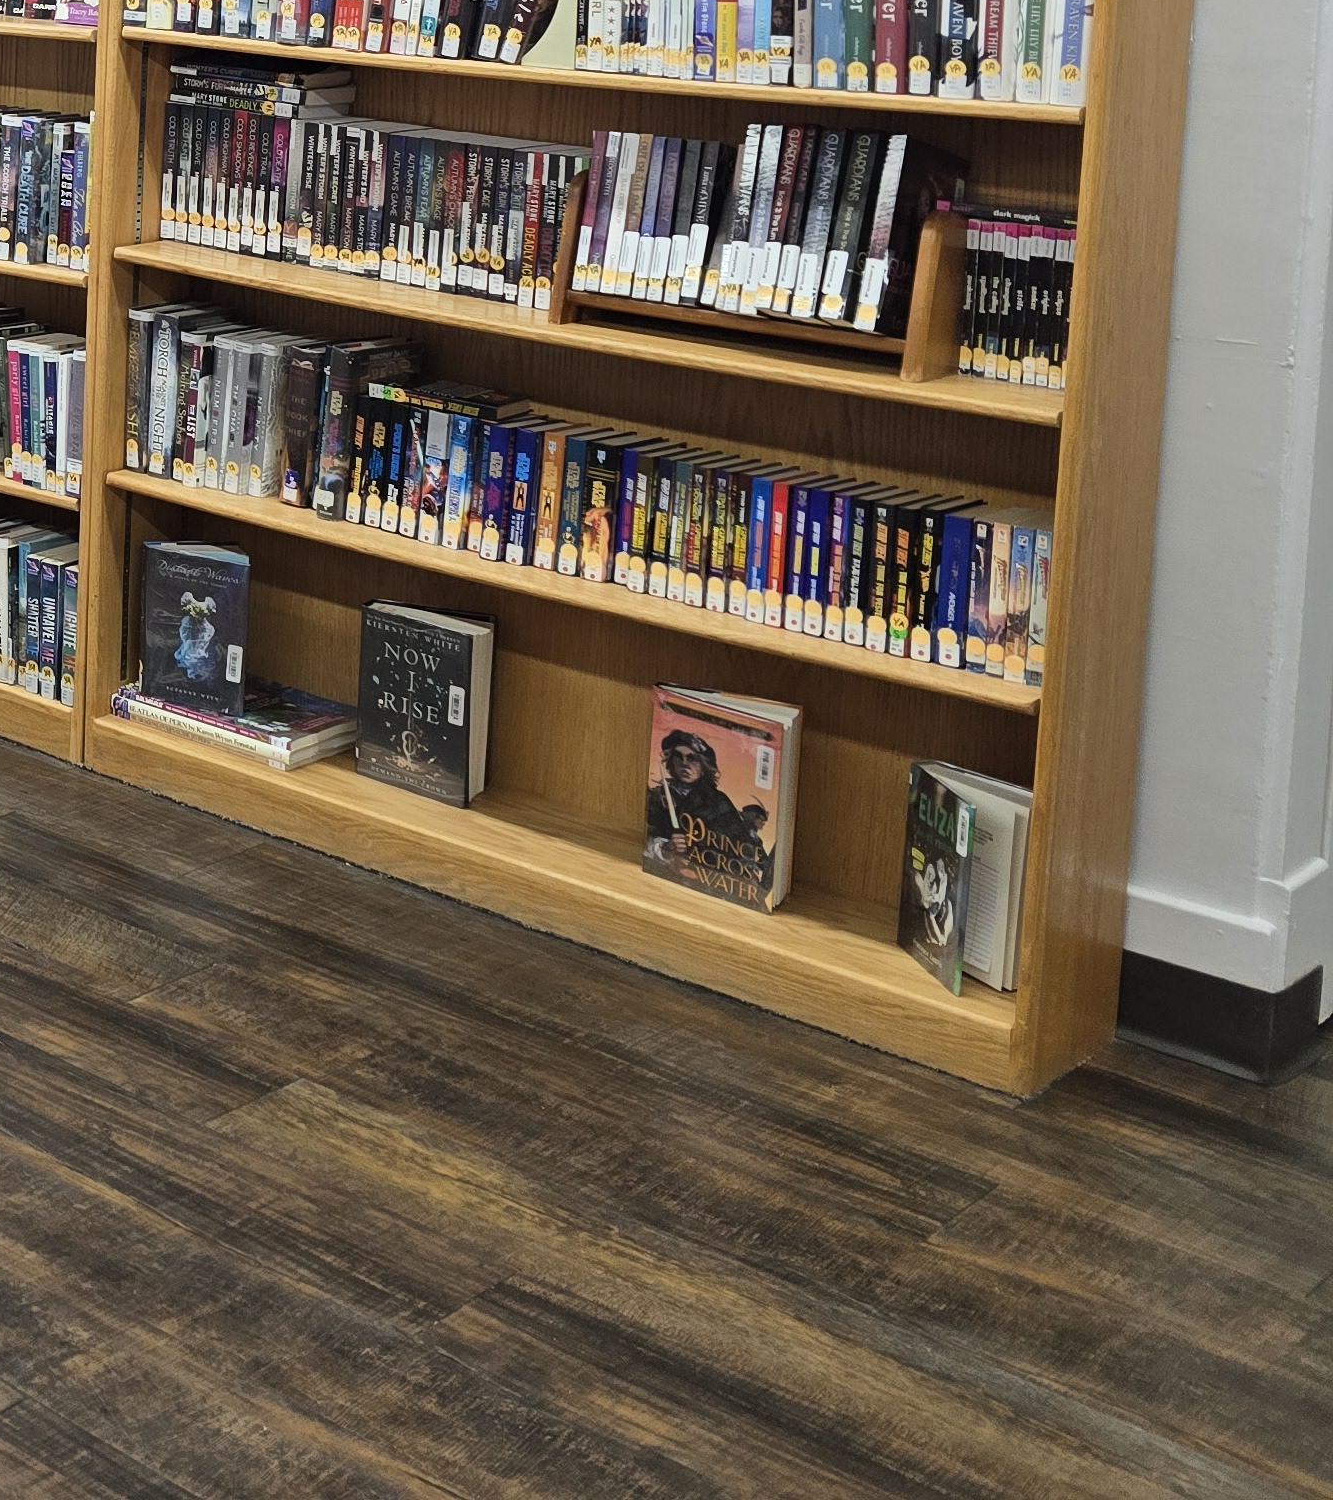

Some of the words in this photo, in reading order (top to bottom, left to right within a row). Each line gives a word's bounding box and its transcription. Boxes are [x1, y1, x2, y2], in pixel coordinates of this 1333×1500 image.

[229, 97, 258, 112] DEADLY
[20, 162, 33, 201] DEATH
[17, 203, 29, 235] CURE
[157, 328, 171, 376] TORCH
[287, 411, 309, 424] BOOK
[156, 559, 204, 580] Distant
[207, 569, 244, 586] Waves
[27, 597, 39, 638] SHATTER
[42, 597, 56, 645] UNRAVEL
[63, 610, 77, 651] IGNITE
[366, 618, 419, 641] KIERSTEN
[424, 636, 461, 653] WHITE
[41, 646, 55, 665] ME
[383, 642, 441, 672] NOW
[408, 671, 416, 693] I
[382, 691, 440, 726] RISE
[918, 791, 956, 843] ELIZA
[679, 812, 764, 864] PRINCE
[688, 851, 764, 883] ACROSS
[694, 869, 760, 902] WATER
